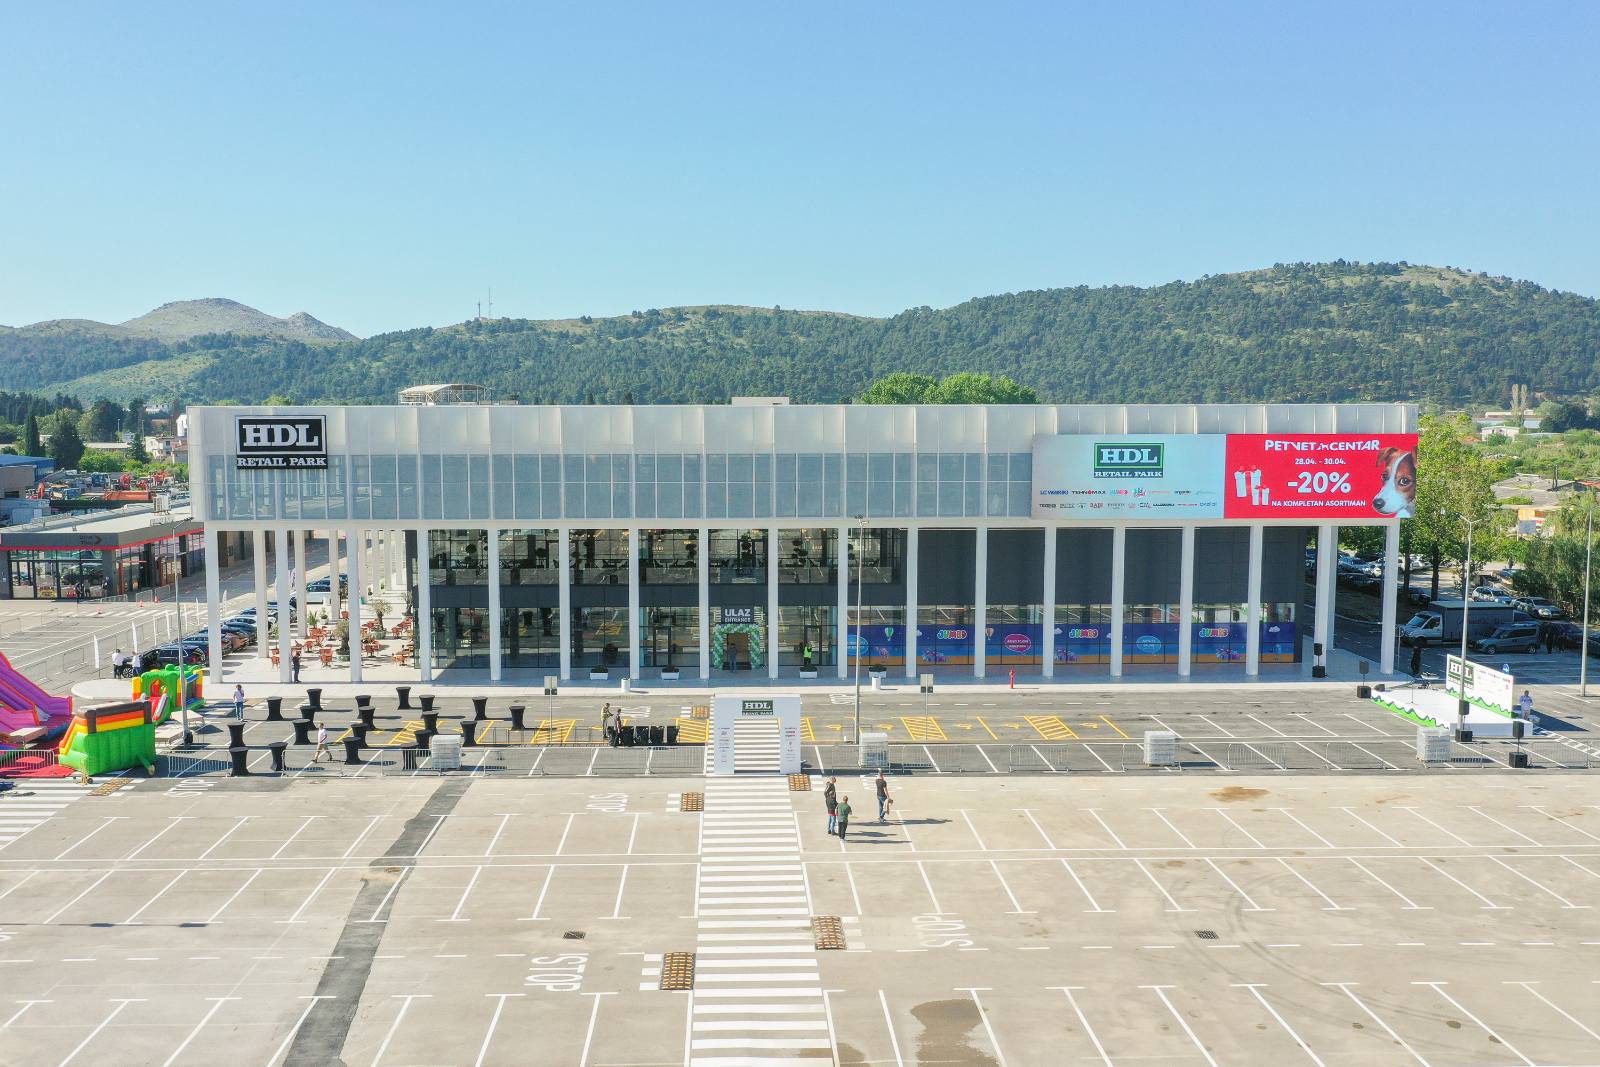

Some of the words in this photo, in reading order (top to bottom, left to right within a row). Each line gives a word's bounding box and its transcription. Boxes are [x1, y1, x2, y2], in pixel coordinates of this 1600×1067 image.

[242, 424, 319, 447] HDL
[237, 457, 287, 467] RETAIL
[289, 457, 327, 466] PARK
[1100, 448, 1158, 464] HDL
[1287, 471, 1351, 494] -20%
[724, 608, 751, 617] ULAZ
[744, 702, 771, 710] HDL
[523, 955, 588, 992] STOP
